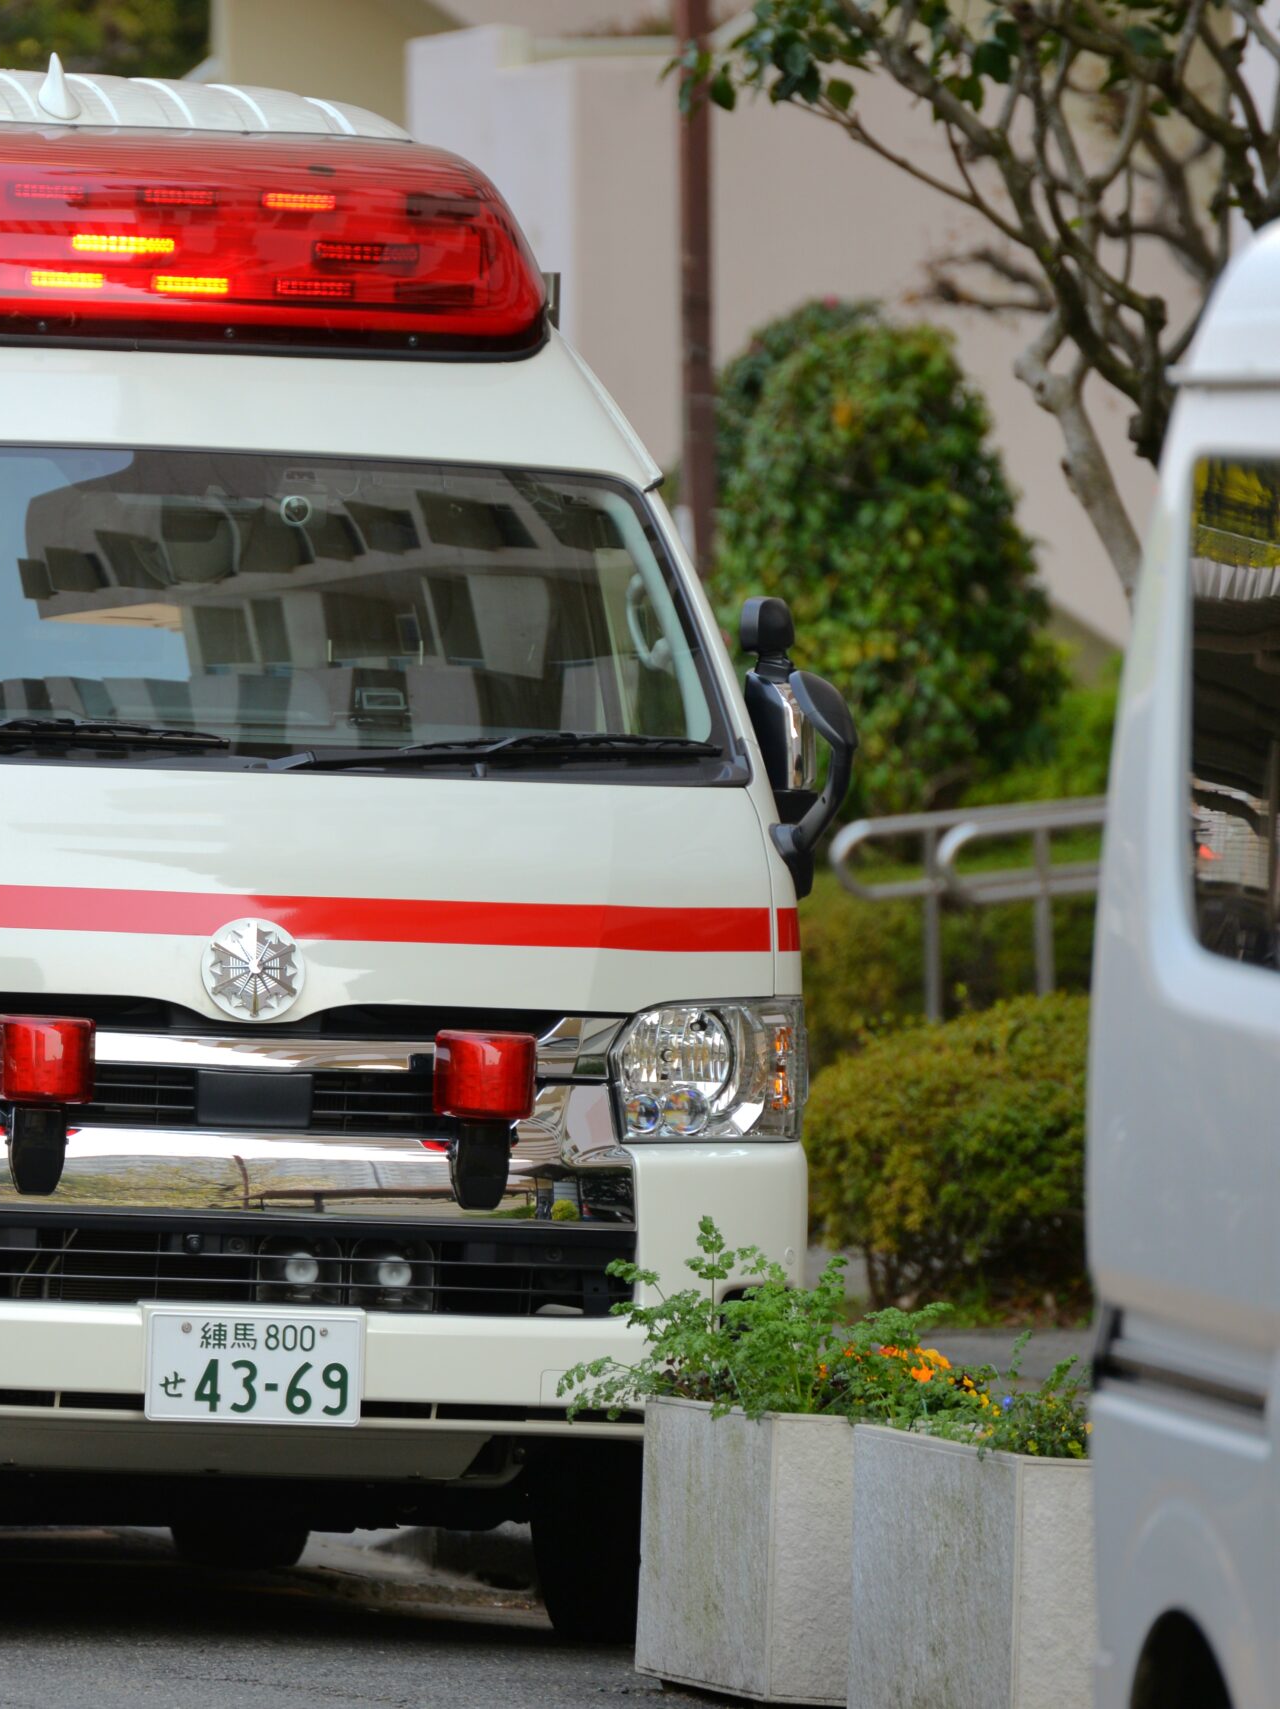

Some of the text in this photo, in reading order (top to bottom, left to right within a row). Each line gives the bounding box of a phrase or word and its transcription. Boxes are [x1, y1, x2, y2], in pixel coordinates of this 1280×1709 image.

[200, 1321, 316, 1352] 練馬 800
[159, 1358, 349, 1416] せ 43-69
